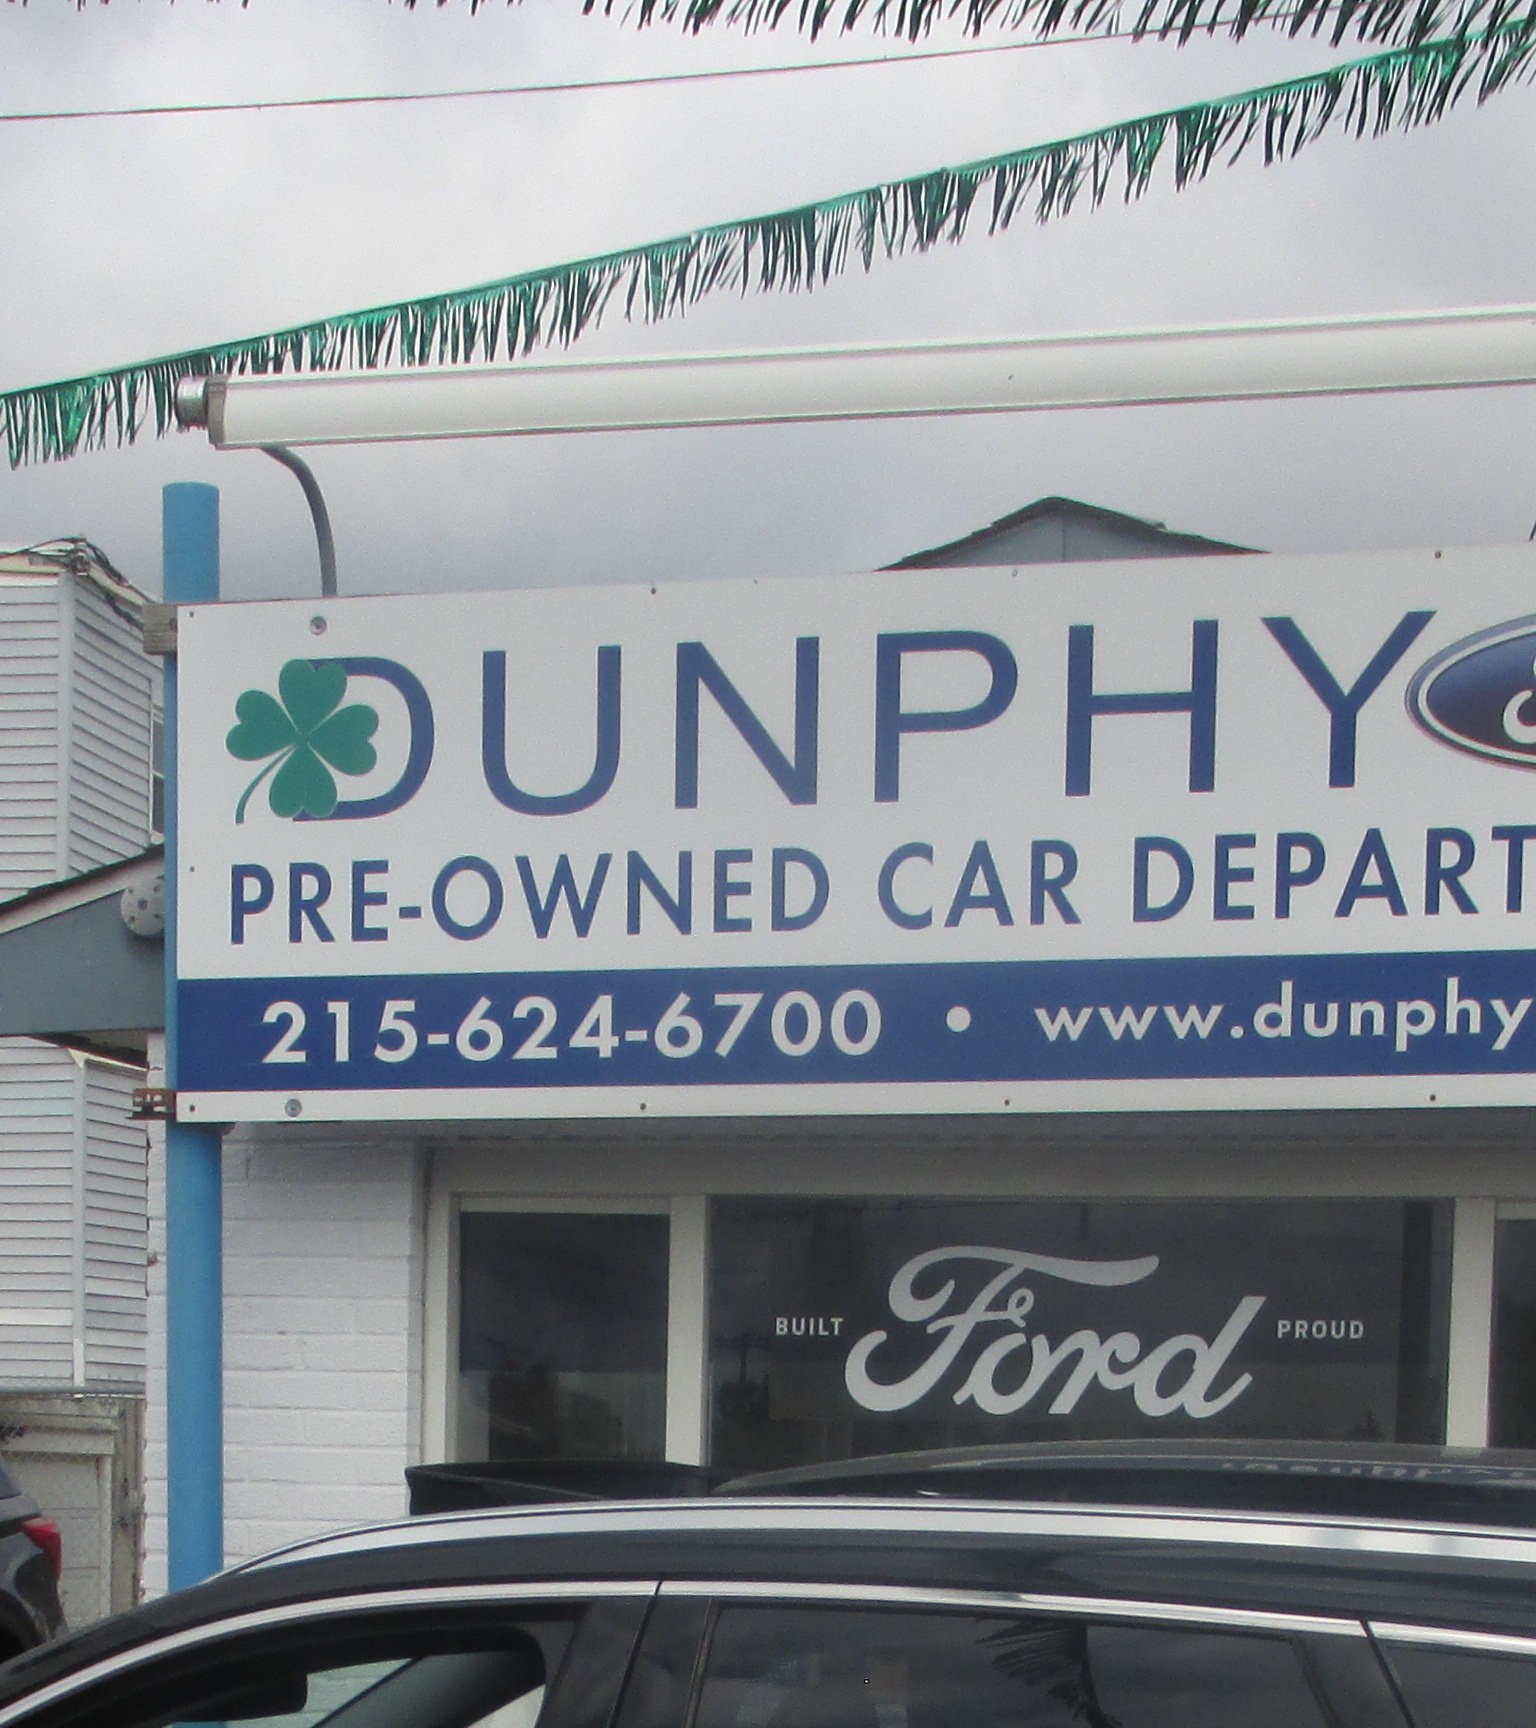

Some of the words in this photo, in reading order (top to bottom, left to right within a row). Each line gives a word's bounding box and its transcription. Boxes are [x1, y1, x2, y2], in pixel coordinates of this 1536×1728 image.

[292, 610, 1437, 822] DUNPHY
[230, 846, 830, 945] PRE-OWNED
[877, 834, 1081, 930] CAR
[262, 989, 882, 1064] 215-624-6700
[775, 1317, 844, 1336] BUILT
[844, 1245, 1267, 1418] Ford
[1276, 1320, 1364, 1339] PROUD
